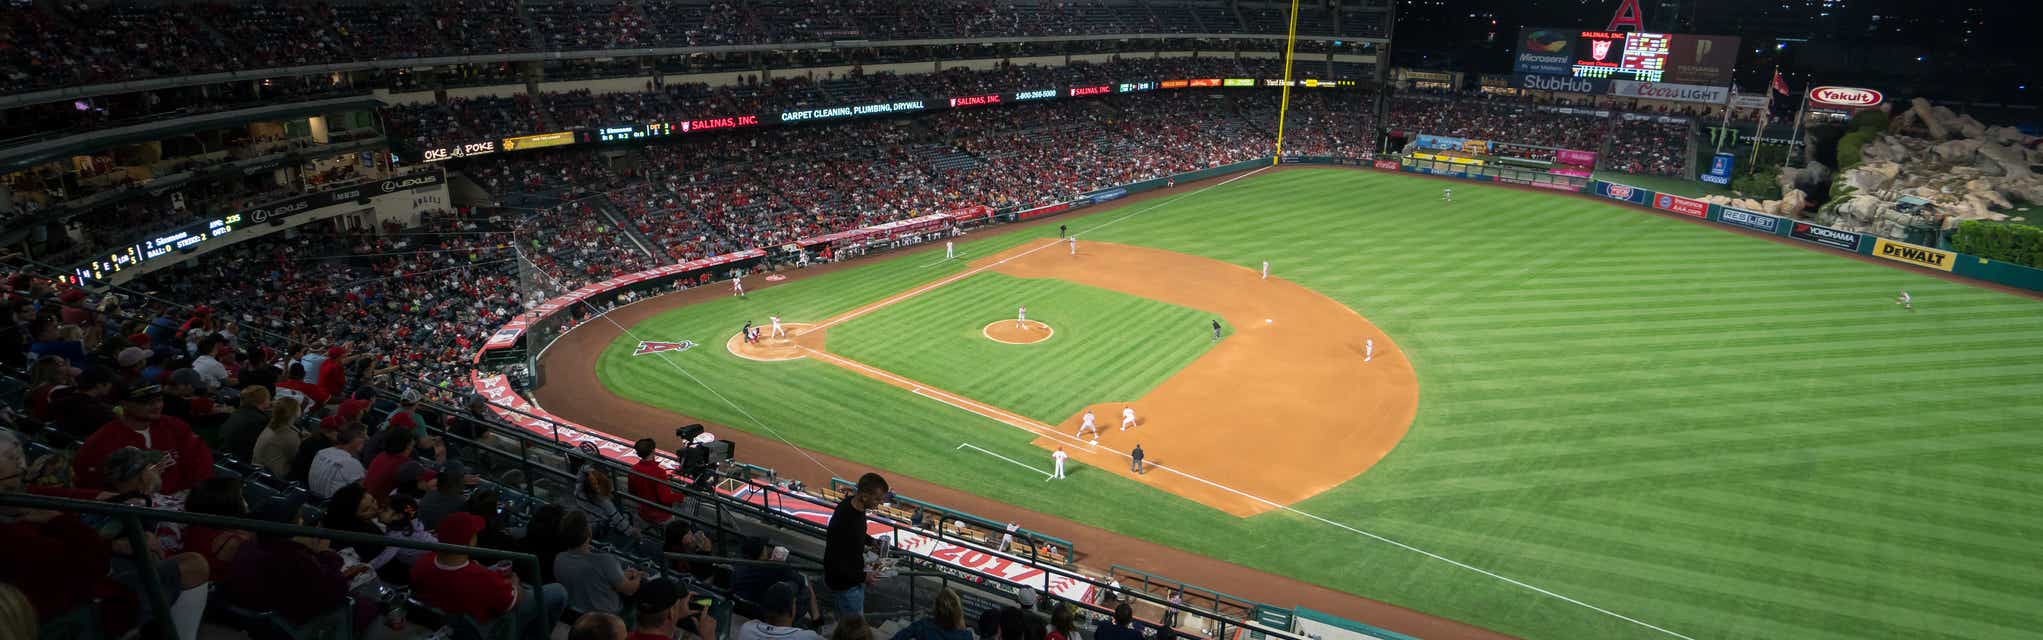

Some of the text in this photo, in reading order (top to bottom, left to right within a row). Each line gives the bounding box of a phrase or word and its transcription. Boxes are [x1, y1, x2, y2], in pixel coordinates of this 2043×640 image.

[1520, 53, 1568, 63] Microsemi
[1075, 86, 1099, 95] SALINAS,
[1100, 85, 1111, 93] INC.
[1524, 75, 1592, 92] StubHub
[1637, 83, 1720, 101] Coors LIGHT
[1823, 91, 1869, 102] Yakult
[957, 95, 1000, 106] SALINAS, INC.
[782, 101, 924, 121] CARPET CLEANING, PLUMBING, DRYWALL
[691, 115, 758, 130] SALINAS, INC.
[424, 148, 447, 160] OKE
[465, 141, 495, 152] POKE
[396, 175, 437, 188] LEXUS
[267, 201, 308, 217] LEXUS
[1809, 226, 1855, 243] YOKOHAMA
[930, 543, 1045, 582] 2017
